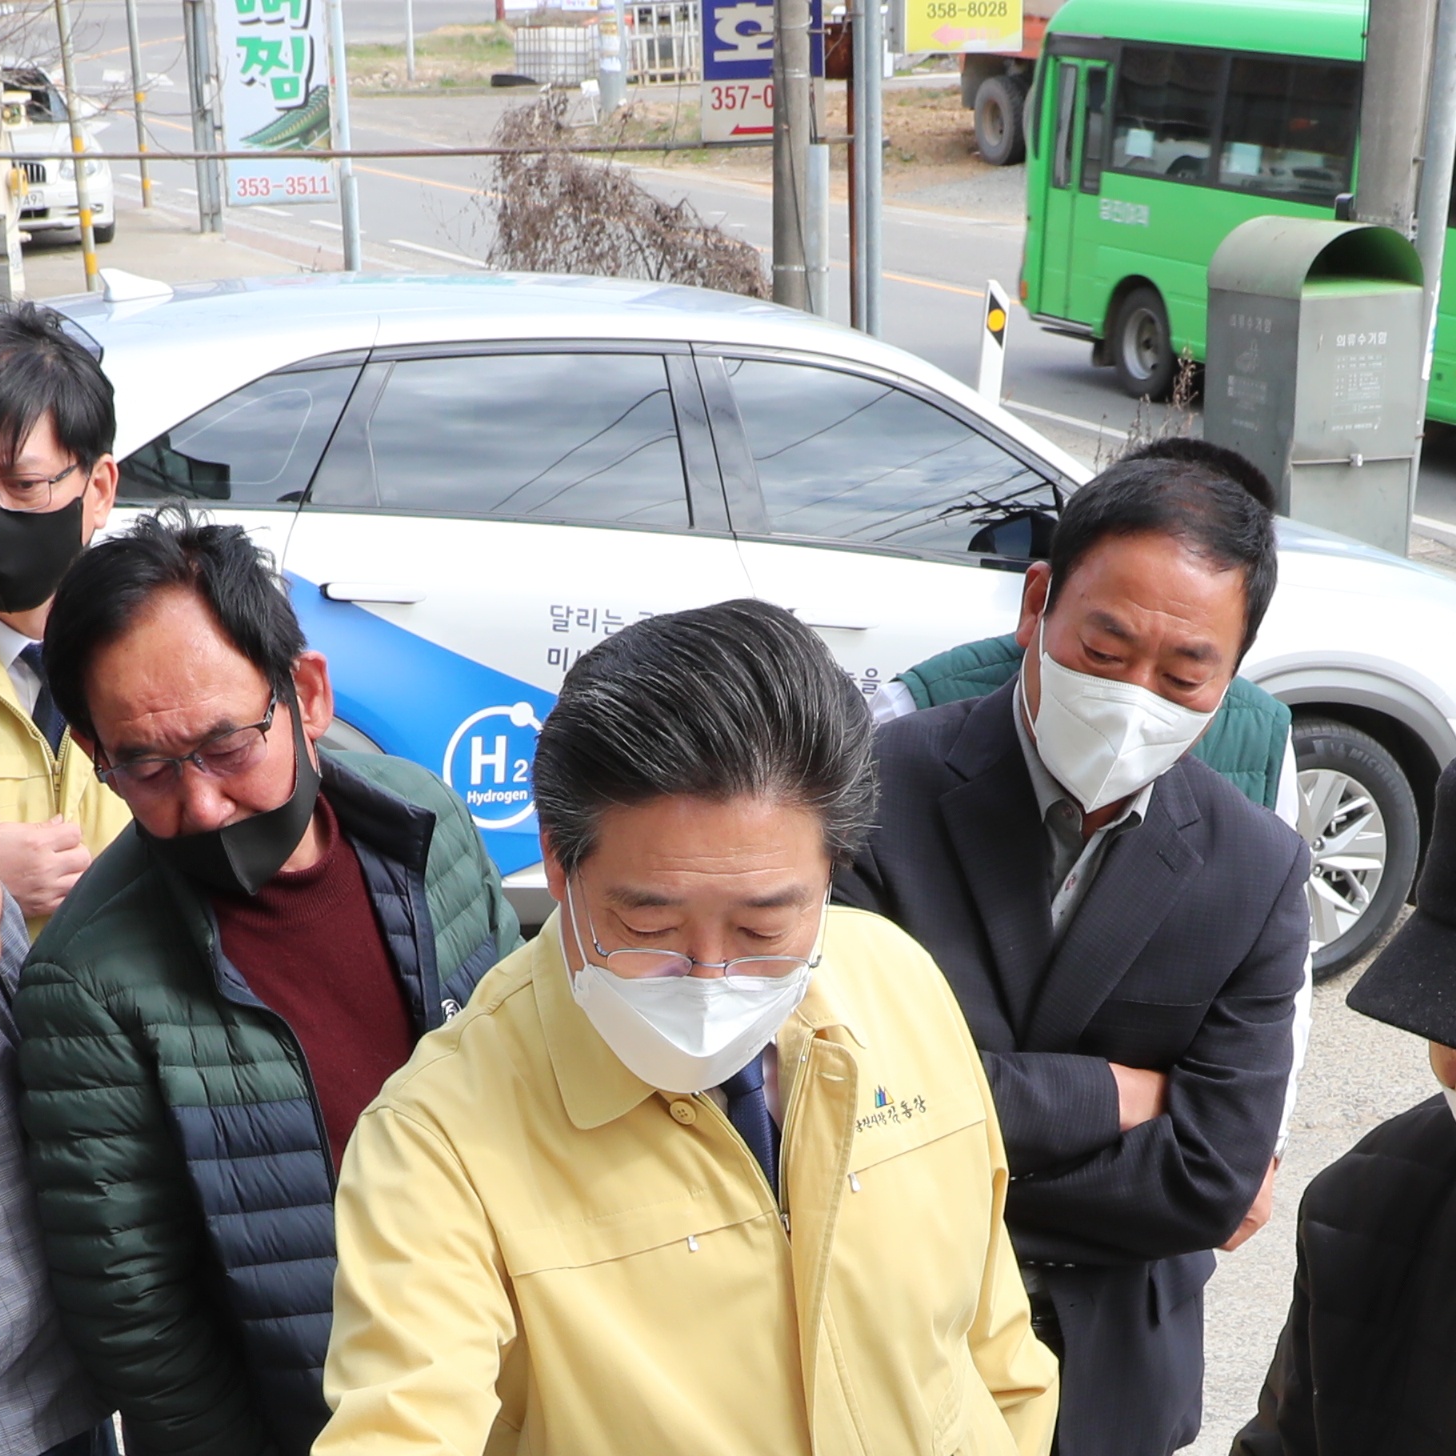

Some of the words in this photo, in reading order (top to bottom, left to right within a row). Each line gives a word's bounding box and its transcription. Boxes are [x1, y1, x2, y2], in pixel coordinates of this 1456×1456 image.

[926, 2, 1008, 19] 358-8028
[236, 176, 331, 197] 353-3511
[549, 604, 625, 636] 달리는
[466, 788, 529, 807] Hydrogen
